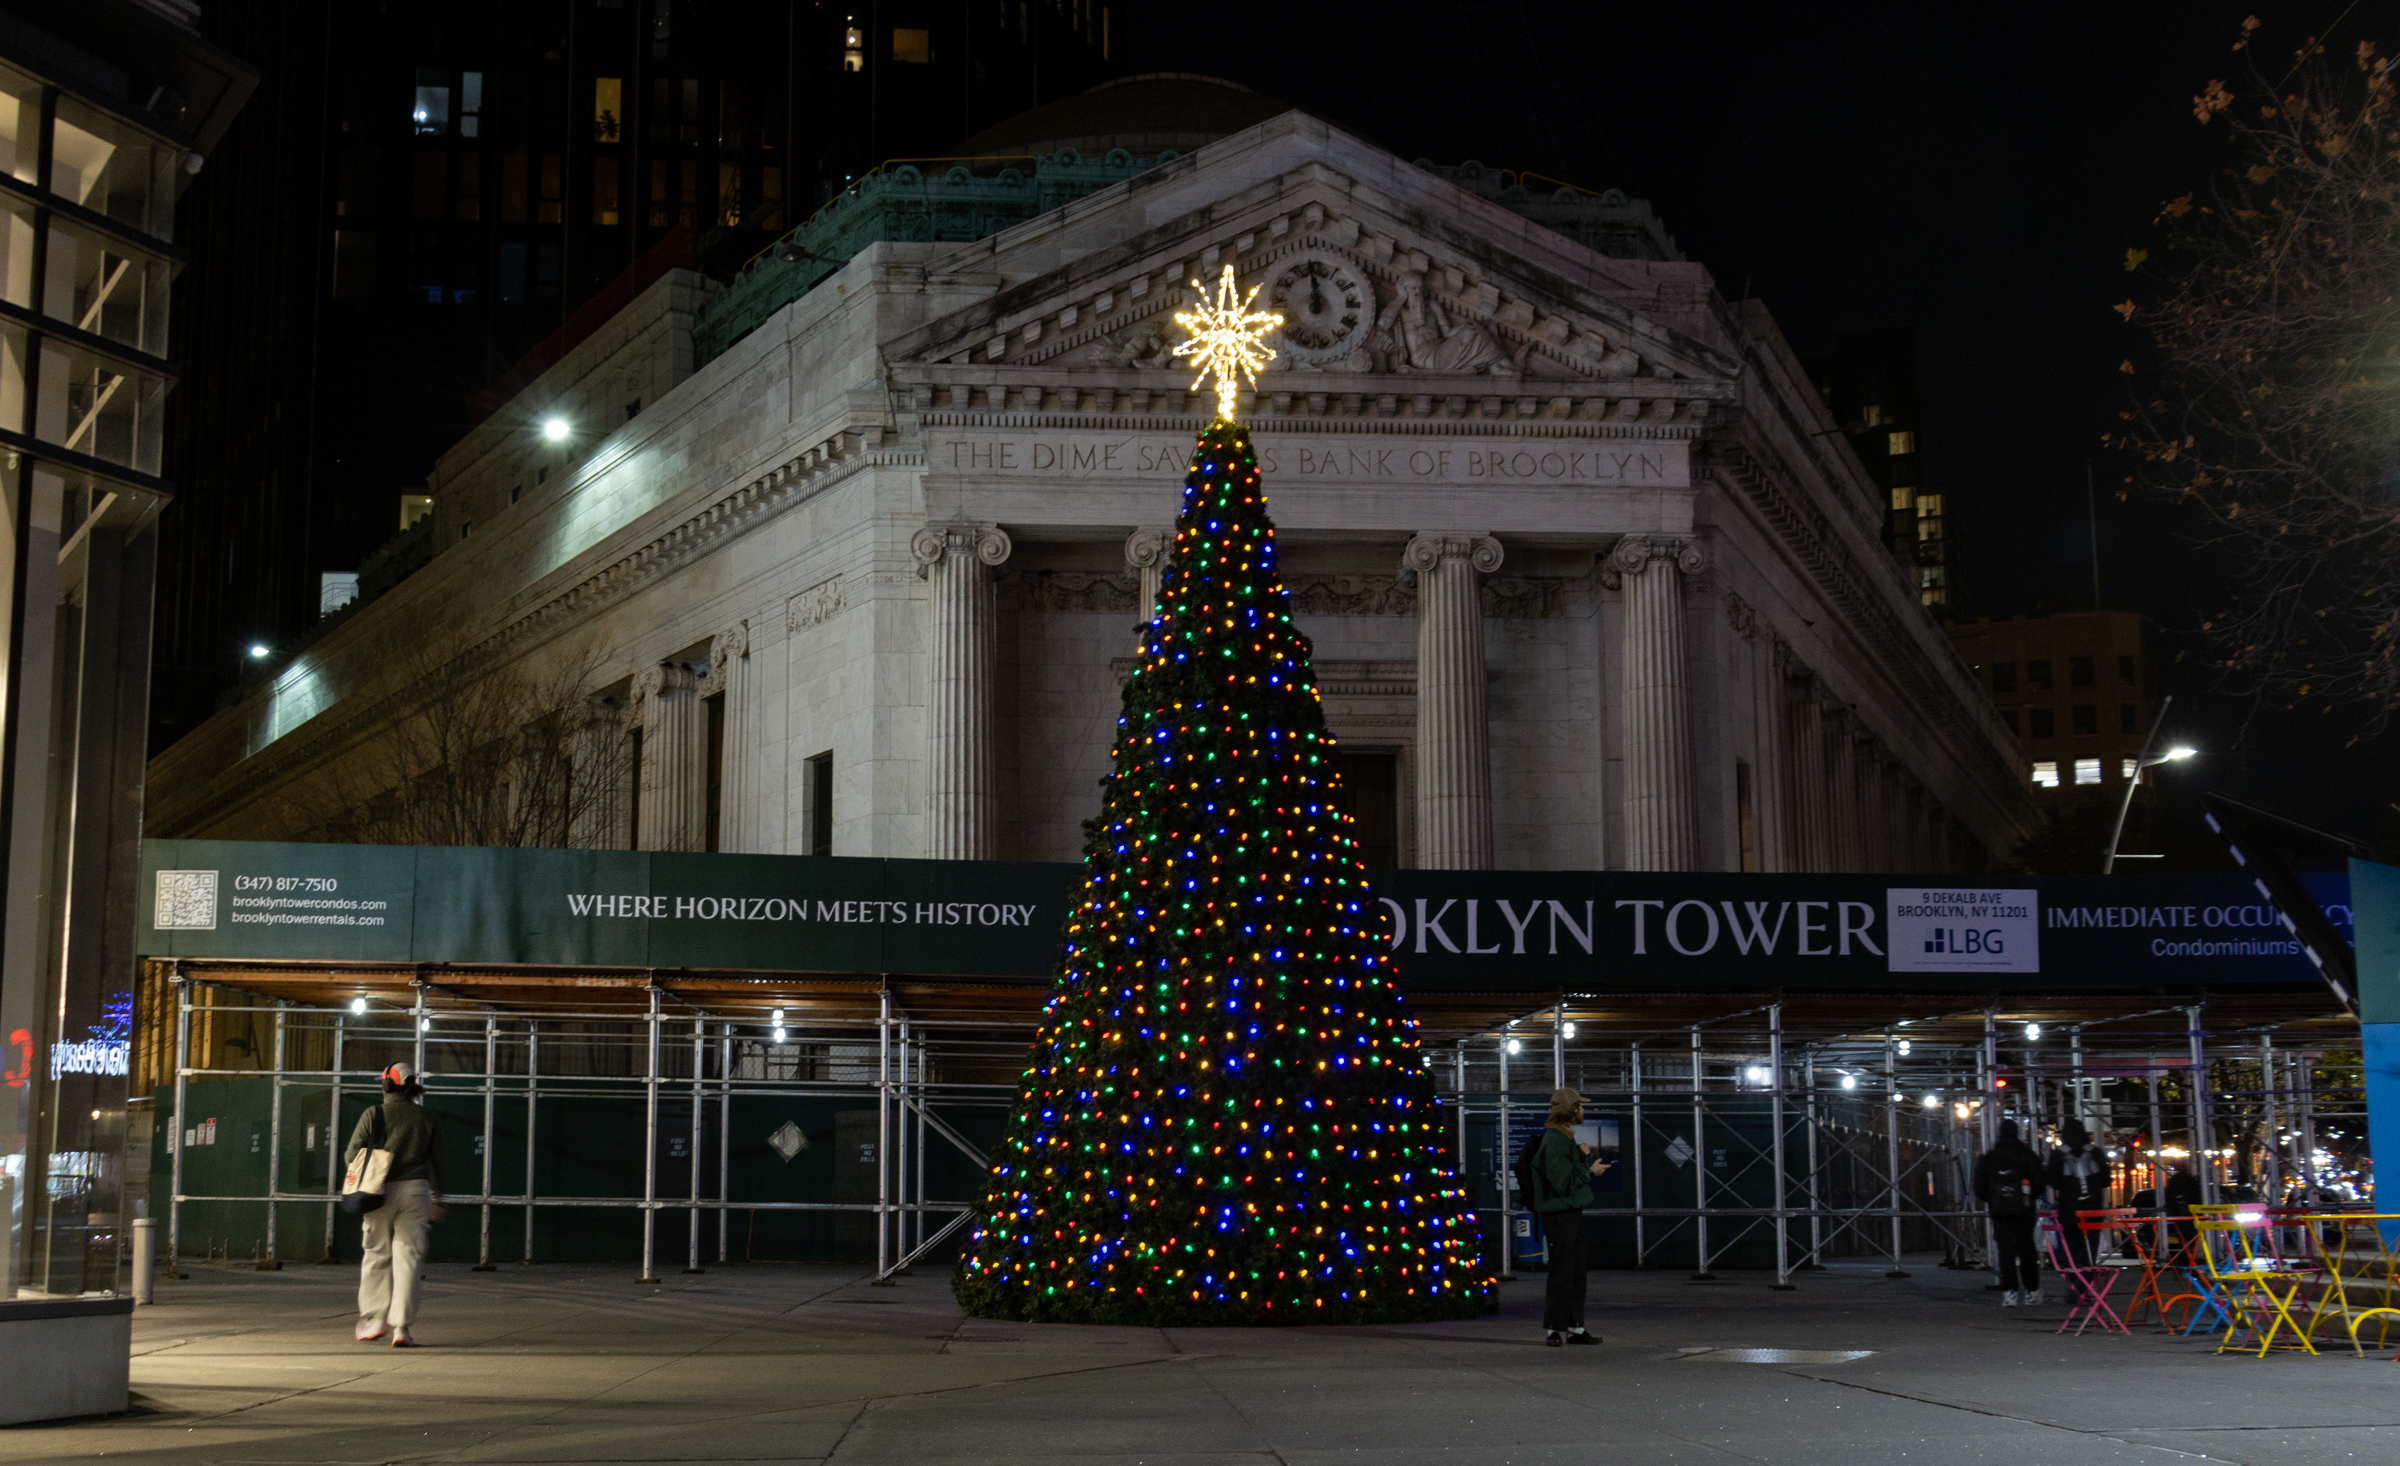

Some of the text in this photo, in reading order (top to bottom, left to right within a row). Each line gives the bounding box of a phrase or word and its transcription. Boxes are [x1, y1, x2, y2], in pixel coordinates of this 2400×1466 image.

[947, 441, 1664, 479] THE DIME SAVS BANK OF BROOKLYN
[234, 875, 338, 892] (347) 817-7510
[232, 896, 387, 911] brooklyntowercondos.com
[1923, 893, 2002, 904] 9 DEKALB AVE
[231, 911, 385, 926] brooklyntowerrentals.com
[567, 894, 1037, 927] WHERE HORIZON MEETS HISTORY
[1898, 905, 2028, 919] BROOKLYN, NY 11201
[2047, 904, 2354, 929] IMMEDIATE OCCUCY
[1378, 896, 1885, 957] KLYN TOWER
[1949, 928, 2003, 954] LBG
[2151, 938, 2300, 957] Condominiums
